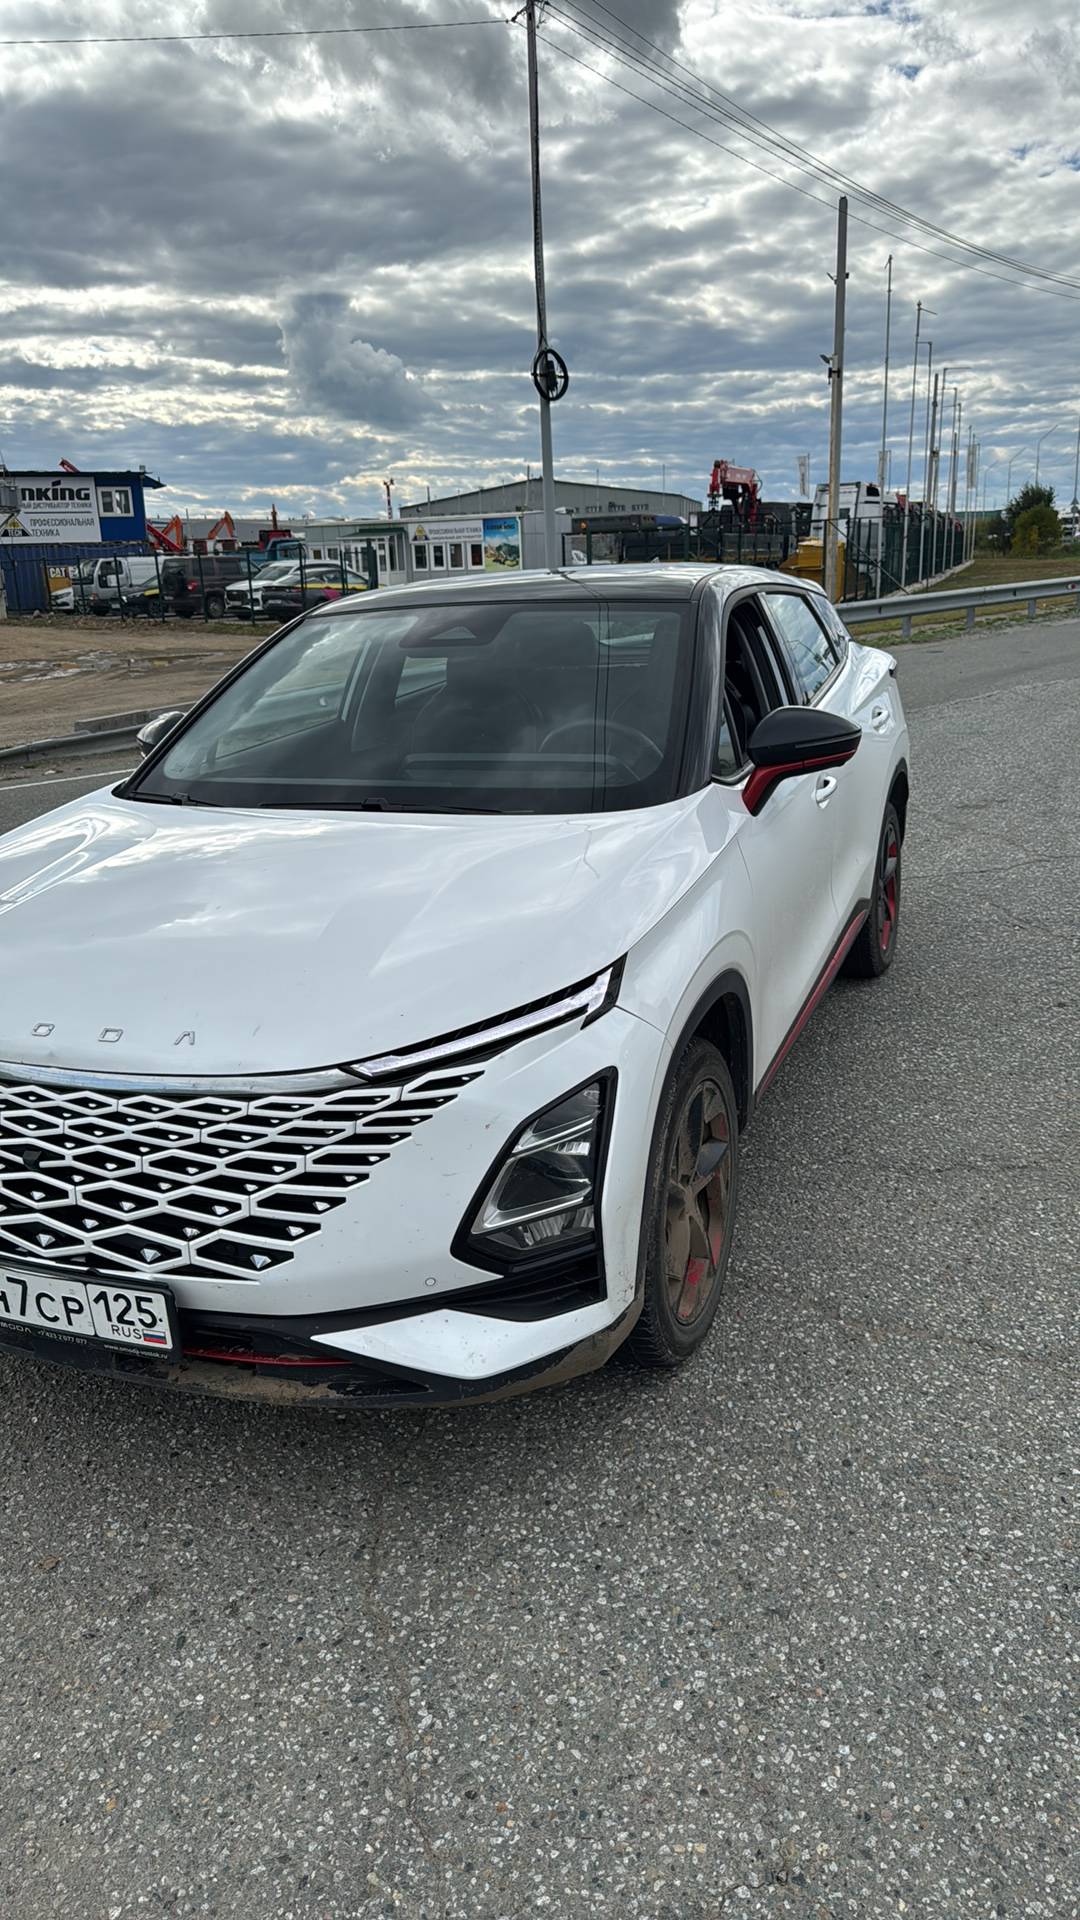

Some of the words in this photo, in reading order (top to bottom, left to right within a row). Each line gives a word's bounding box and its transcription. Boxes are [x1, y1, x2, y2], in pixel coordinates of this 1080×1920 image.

[30, 518, 95, 527] ПРОФЕССИОНАЛЬНАЯ
[31, 528, 60, 537] ТЕХНИКА
[93, 1291, 158, 1329] 125
[111, 1324, 142, 1340] RUS
